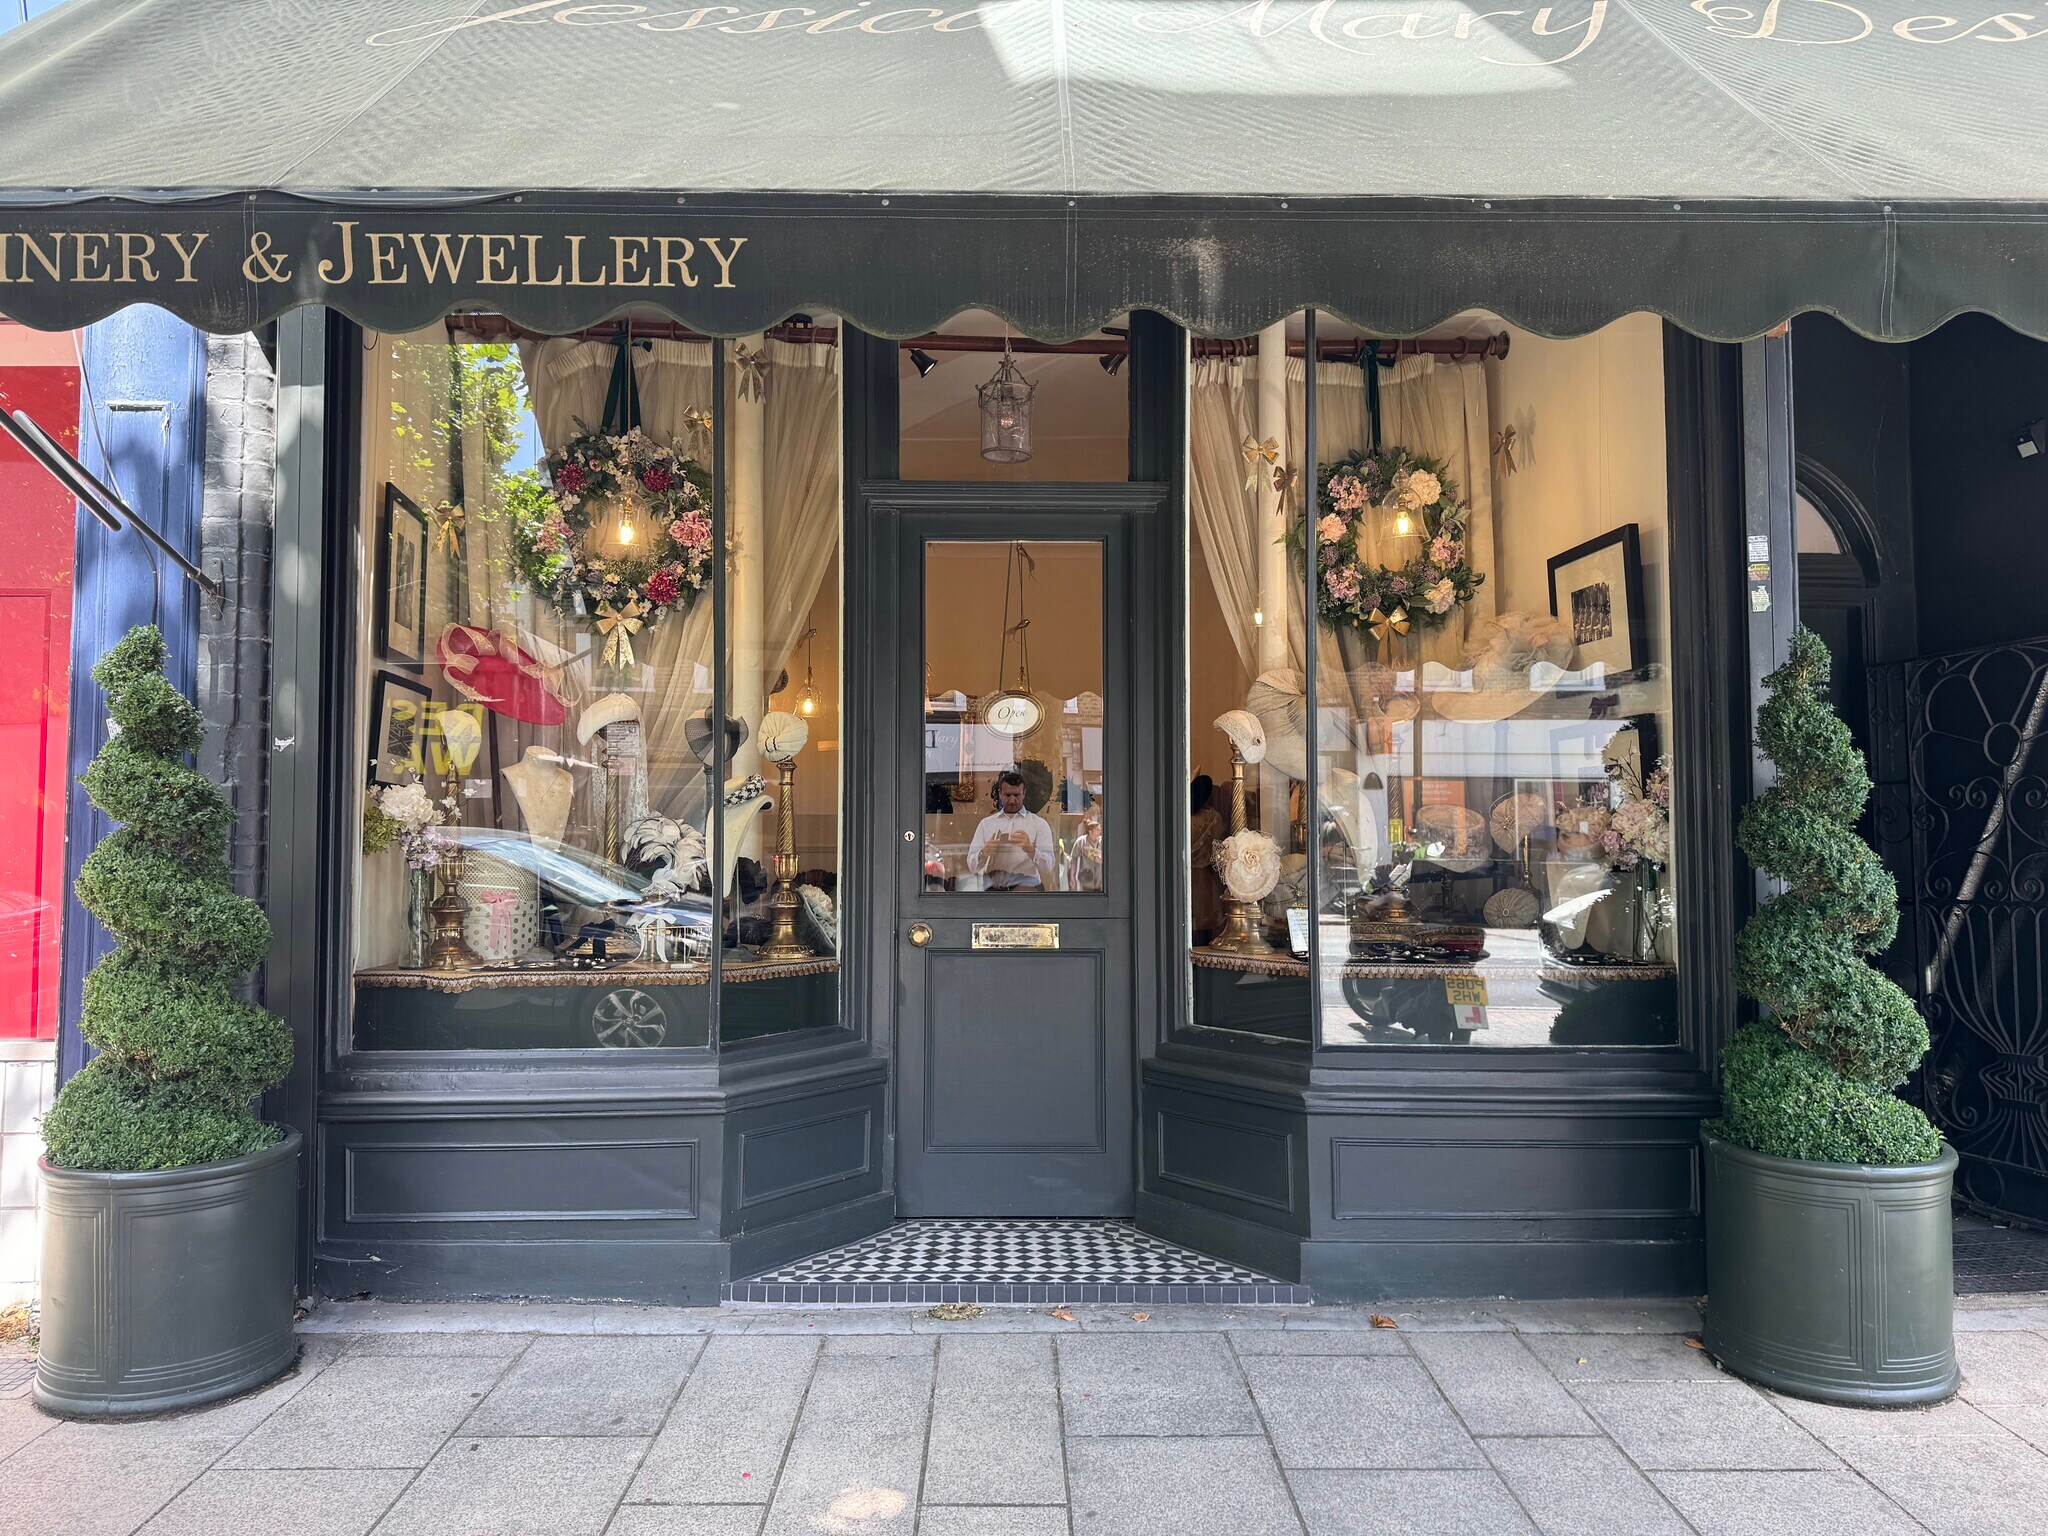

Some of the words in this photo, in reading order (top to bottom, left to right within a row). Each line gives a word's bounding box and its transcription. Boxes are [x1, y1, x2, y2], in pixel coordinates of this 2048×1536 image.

[1132, 0, 1606, 66] Mary
[0, 232, 210, 283] INERY
[242, 231, 292, 283] &
[997, 706, 1026, 731] Open
